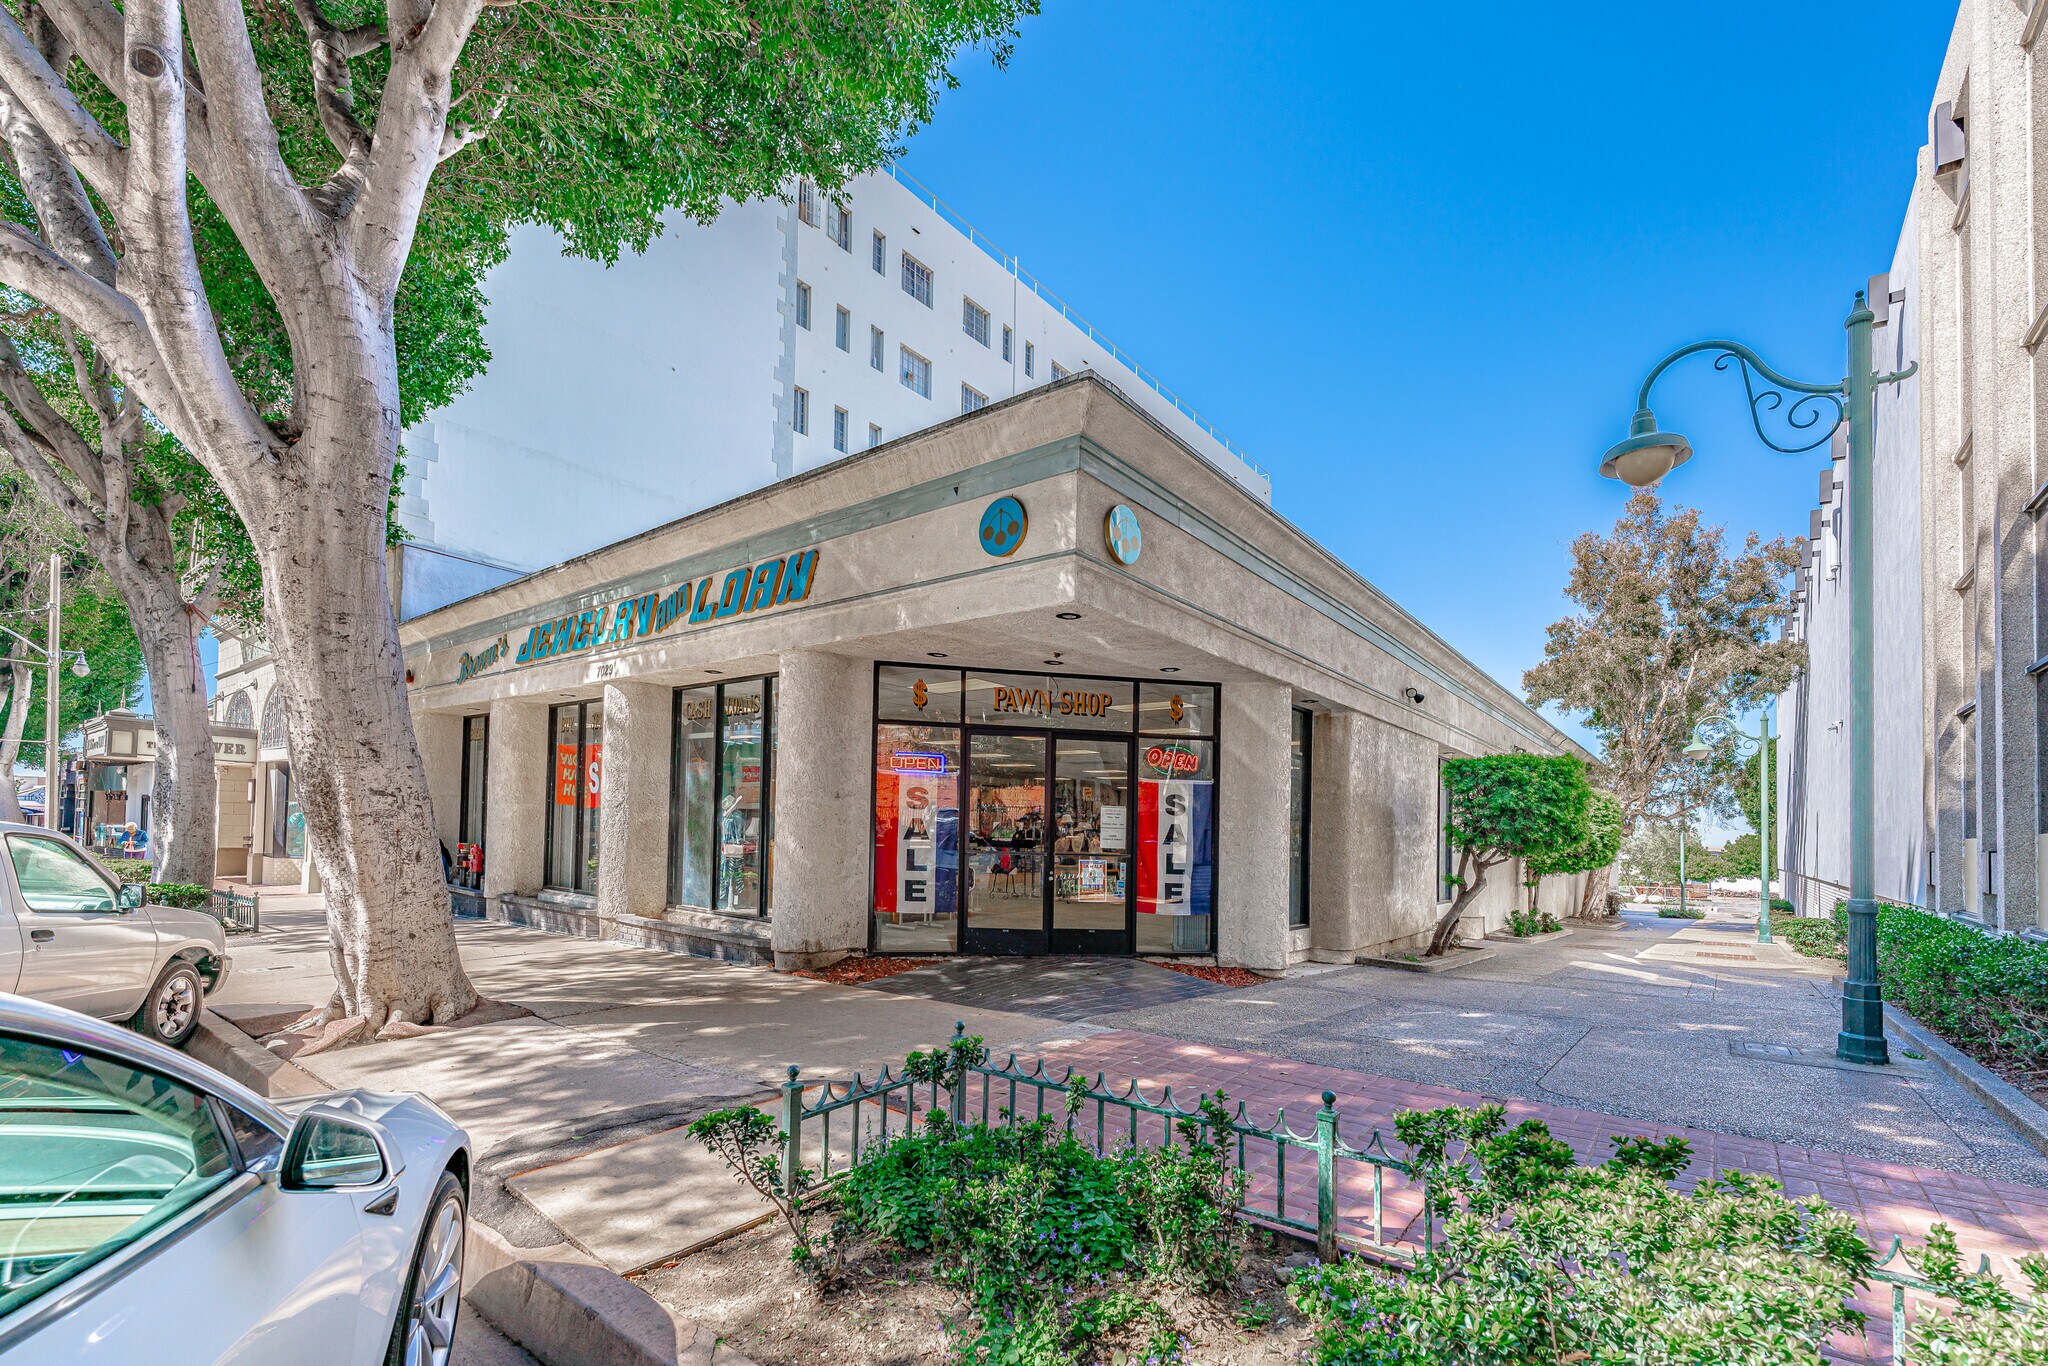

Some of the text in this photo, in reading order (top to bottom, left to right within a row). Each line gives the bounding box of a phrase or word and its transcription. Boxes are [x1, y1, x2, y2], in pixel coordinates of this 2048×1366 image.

[515, 593, 659, 665] JEWELRY
[655, 582, 692, 634] AND
[688, 549, 819, 625] LOAN
[684, 698, 712, 720] CASH
[994, 687, 1112, 717] PAWN SHOP
[214, 742, 247, 755] VER
[1147, 748, 1199, 772] OPEN
[890, 756, 941, 771] OPEN
[903, 786, 930, 902] SALE
[1162, 793, 1187, 904] SALE
